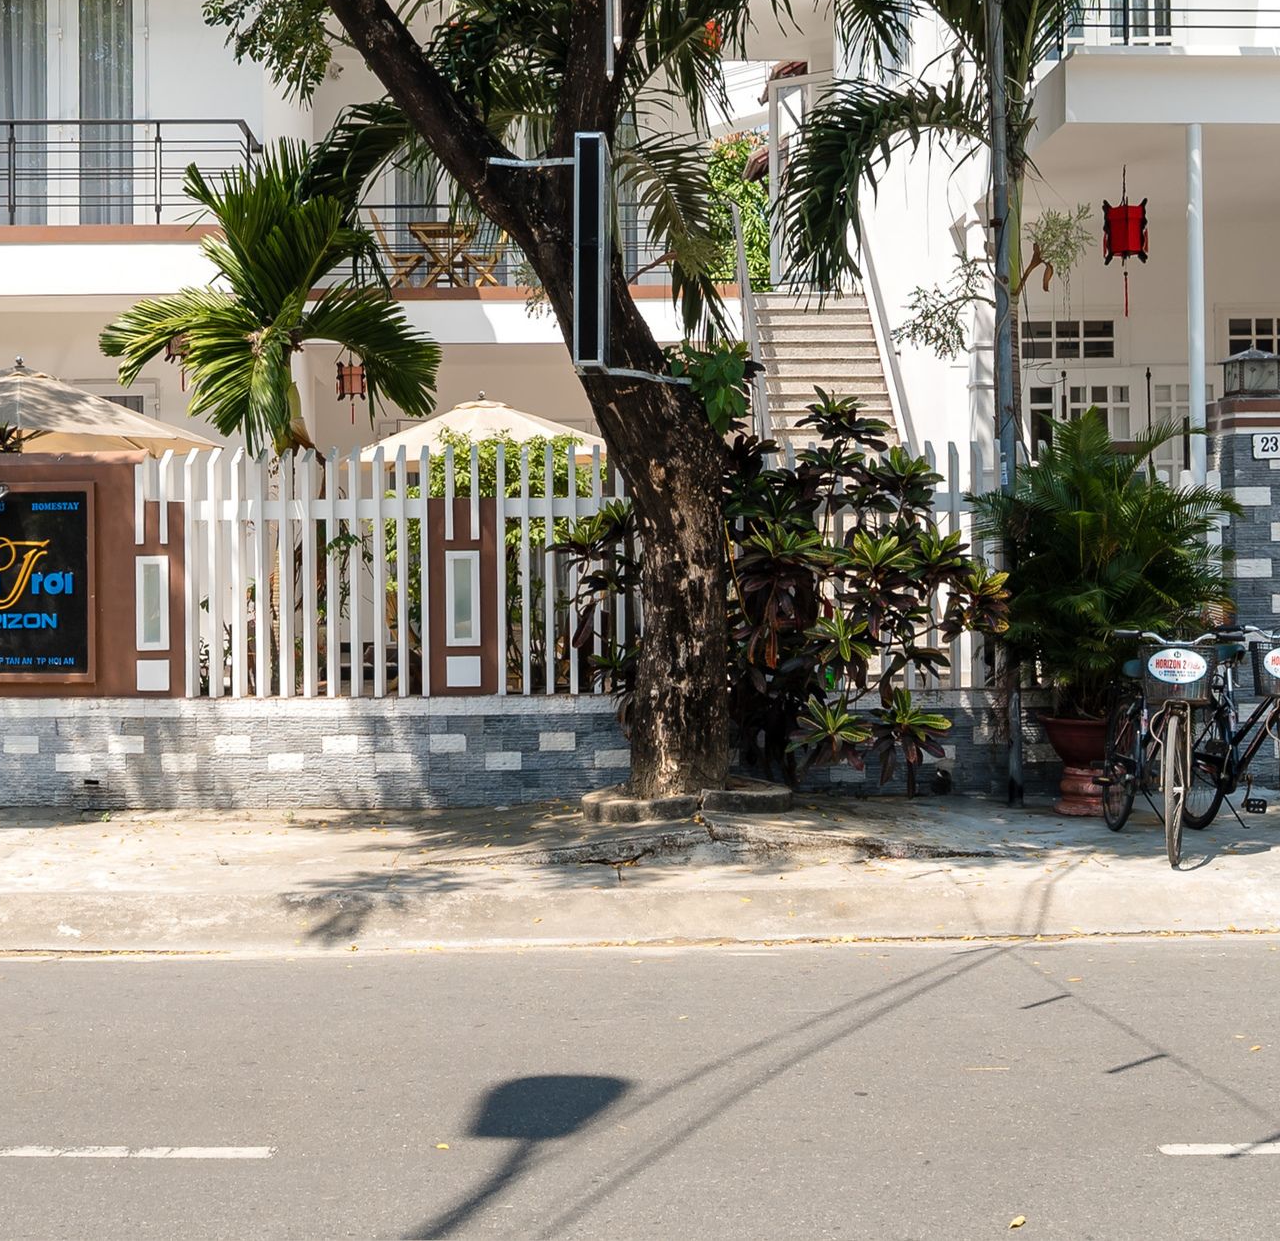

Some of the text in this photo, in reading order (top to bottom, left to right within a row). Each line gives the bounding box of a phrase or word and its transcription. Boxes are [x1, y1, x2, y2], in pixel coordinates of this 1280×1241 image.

[1261, 436, 1278, 452] 23
[31, 502, 80, 511] HOMESTAY
[1155, 658, 1181, 669] HORIZON
[1183, 660, 1187, 669] 2
